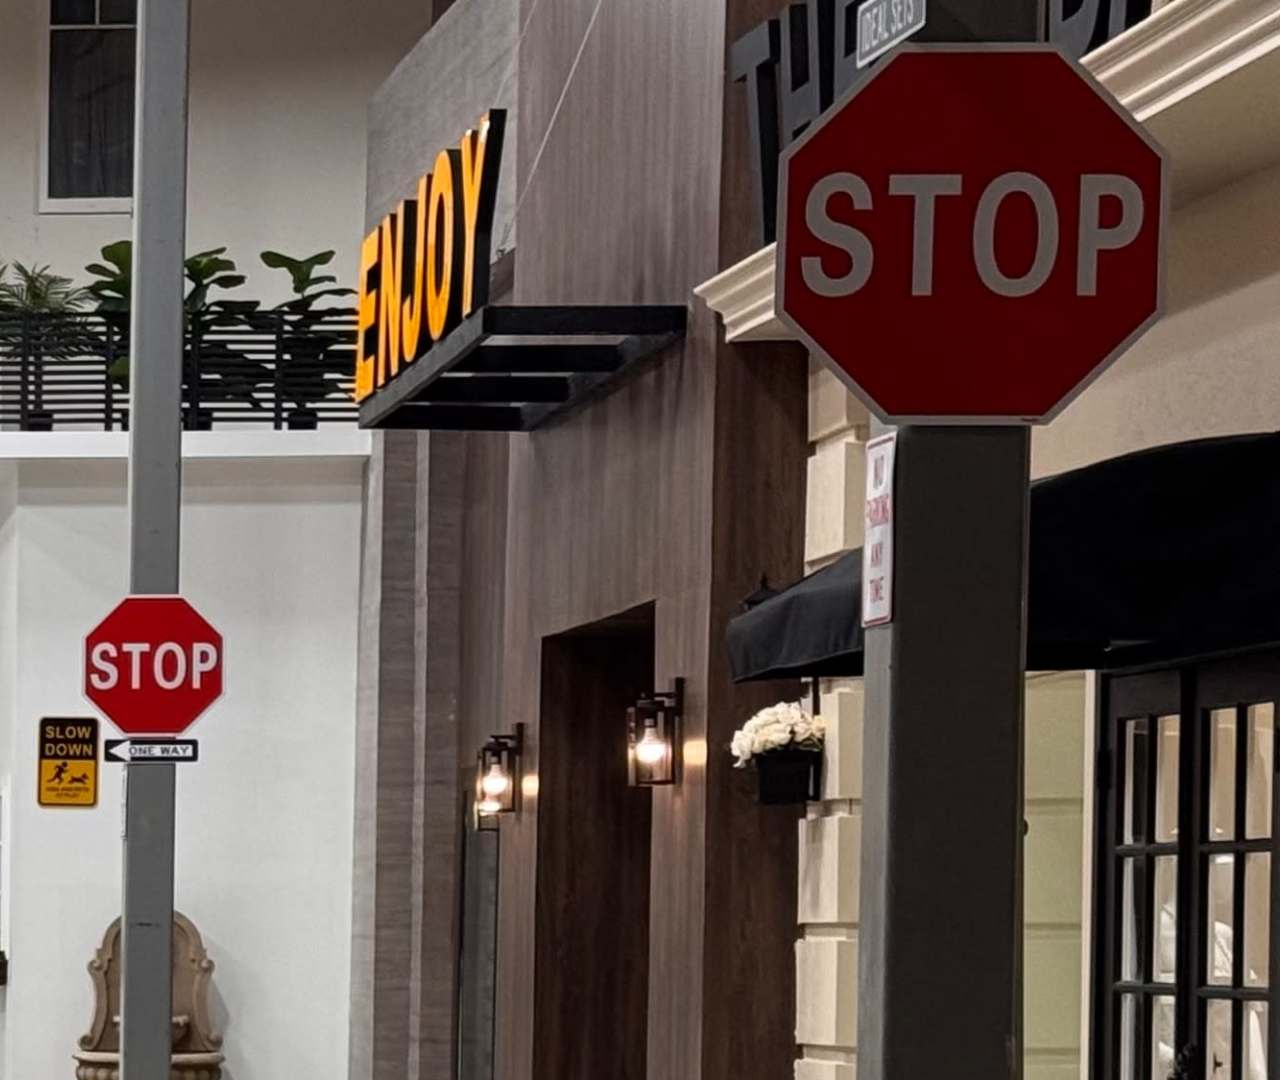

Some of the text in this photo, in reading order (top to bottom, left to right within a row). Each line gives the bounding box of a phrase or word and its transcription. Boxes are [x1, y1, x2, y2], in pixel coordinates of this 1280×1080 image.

[799, 171, 1145, 298] STOP
[354, 111, 491, 405] ENJOY
[90, 641, 218, 690] STOP
[45, 725, 92, 739] SLOW
[44, 743, 93, 757] DOWN
[128, 745, 190, 757] ONE WAY
